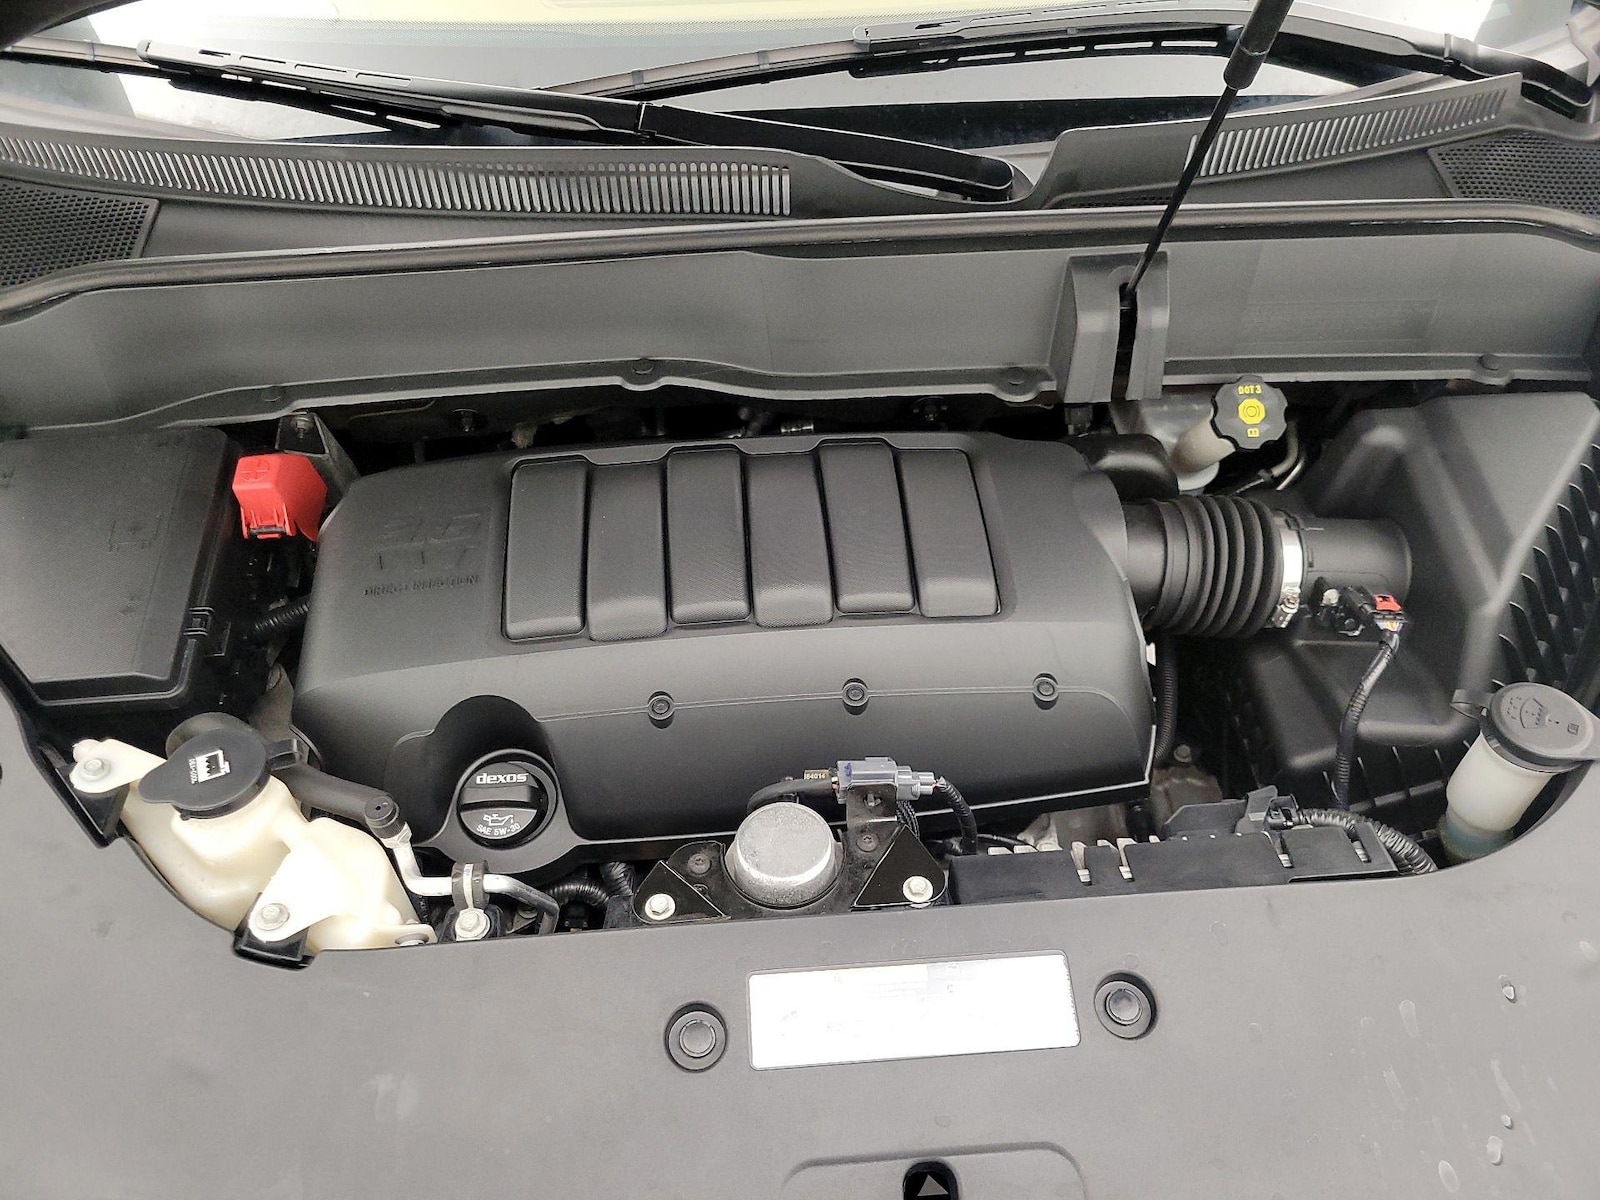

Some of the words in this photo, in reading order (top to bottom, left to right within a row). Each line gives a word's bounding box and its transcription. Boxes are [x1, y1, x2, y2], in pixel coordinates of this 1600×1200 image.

[1238, 385, 1254, 394] DOT
[1255, 384, 1262, 394] 3
[476, 772, 529, 784] dexos
[476, 824, 492, 835] SAE
[494, 823, 521, 836] 5W-30
